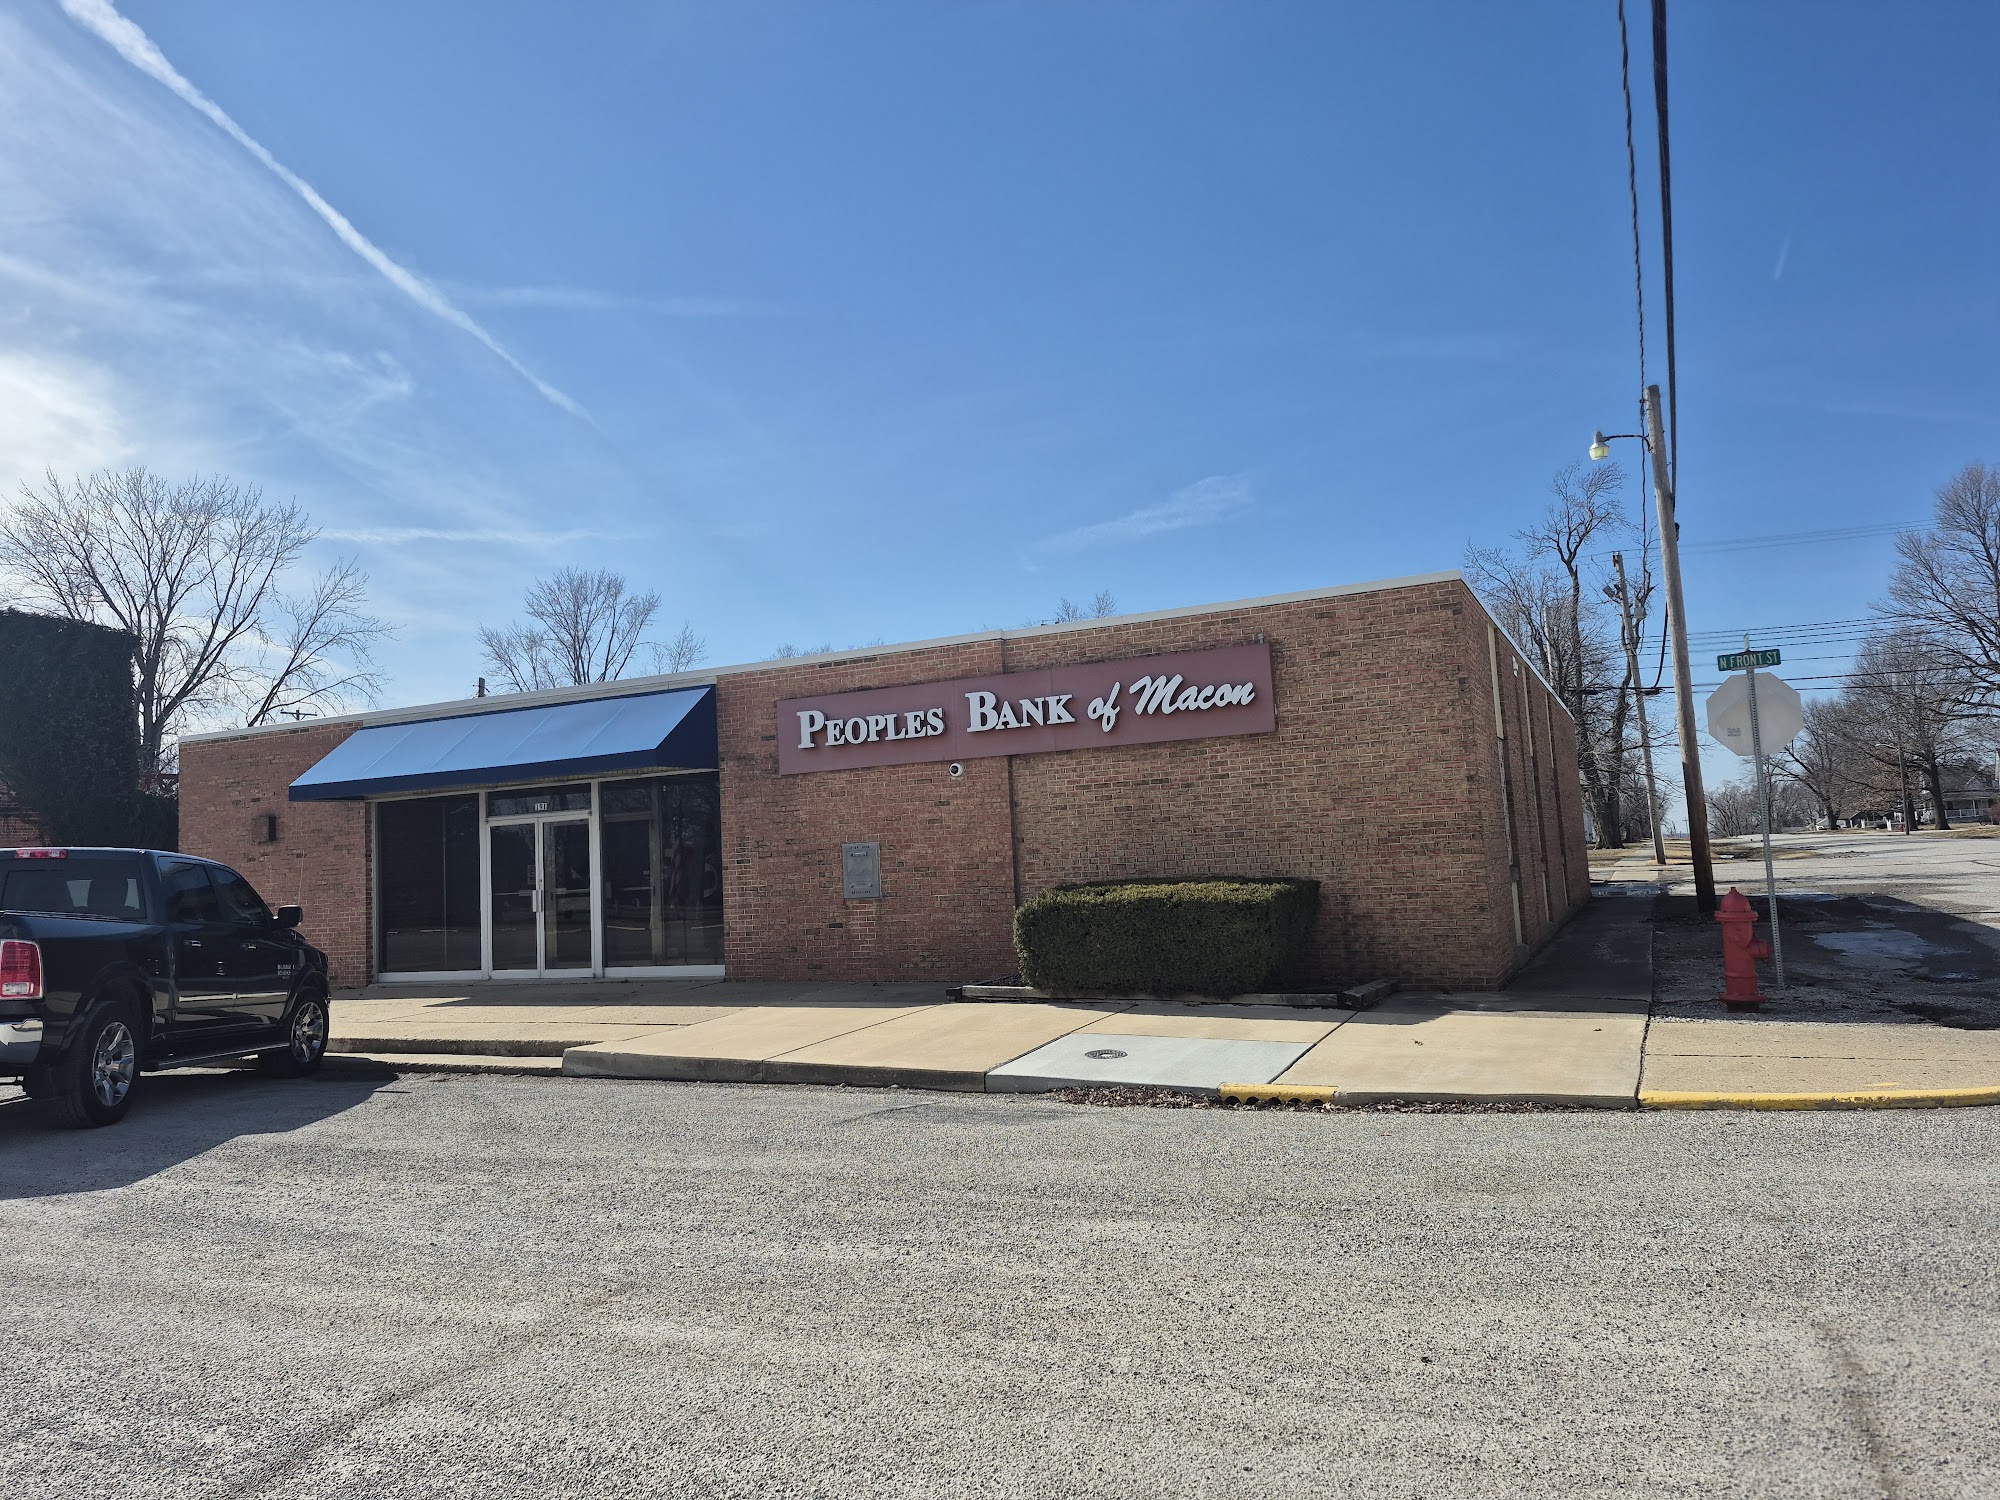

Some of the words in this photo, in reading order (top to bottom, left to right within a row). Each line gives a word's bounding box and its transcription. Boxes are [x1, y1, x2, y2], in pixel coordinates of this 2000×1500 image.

[1720, 657, 1727, 669] N
[1730, 653, 1763, 668] FRONT
[1766, 651, 1778, 664] ST
[796, 707, 945, 749] PEOPLES
[964, 691, 1076, 733] BANK
[1087, 681, 1121, 733] of
[1128, 673, 1256, 715] Macon
